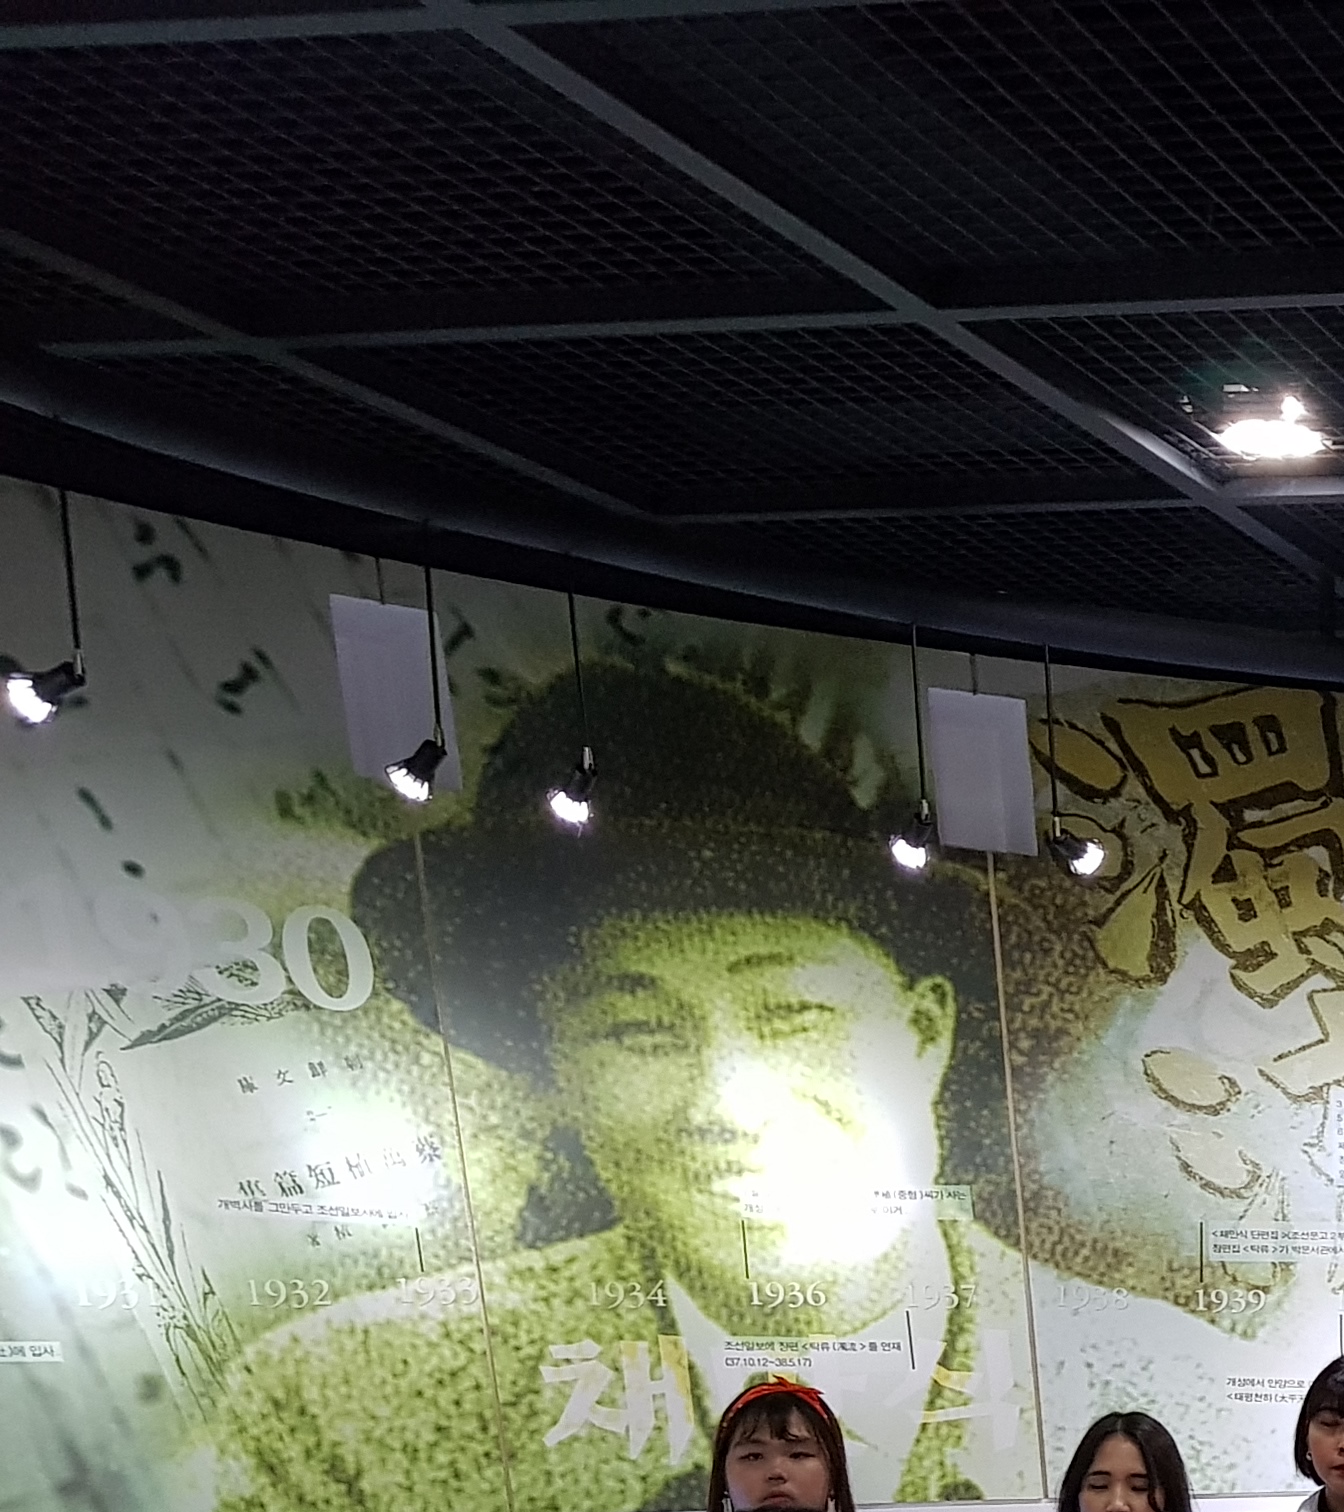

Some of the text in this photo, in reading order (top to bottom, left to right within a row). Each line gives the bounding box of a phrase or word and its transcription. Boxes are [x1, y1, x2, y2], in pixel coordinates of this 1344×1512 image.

[247, 1278, 332, 1309] 1932
[398, 1276, 478, 1307] 1933
[588, 1281, 667, 1309] 1934
[750, 1280, 827, 1309] 1936
[906, 1283, 977, 1310] 1937
[1195, 1288, 1267, 1313] 1939
